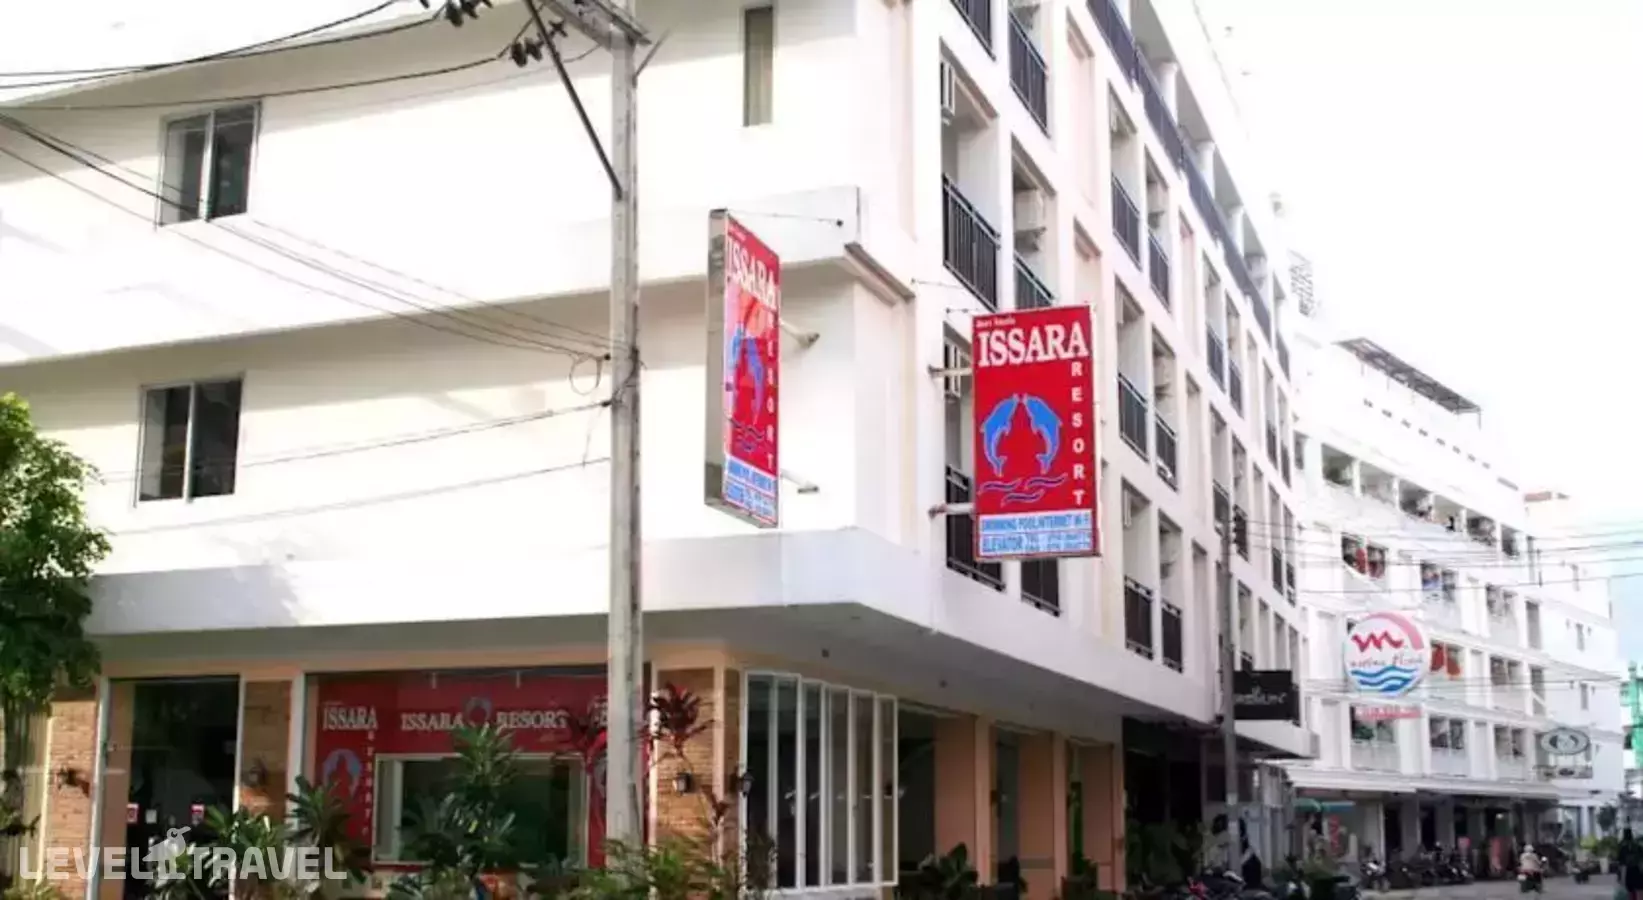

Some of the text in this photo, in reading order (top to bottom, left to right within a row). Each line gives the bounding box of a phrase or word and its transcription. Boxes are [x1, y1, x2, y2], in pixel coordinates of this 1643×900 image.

[727, 236, 778, 311] ISSARA
[977, 320, 1090, 368] ISSARA
[1070, 361, 1086, 506] RESORT
[322, 704, 378, 731] ISSARA
[401, 711, 464, 731] ISSARA
